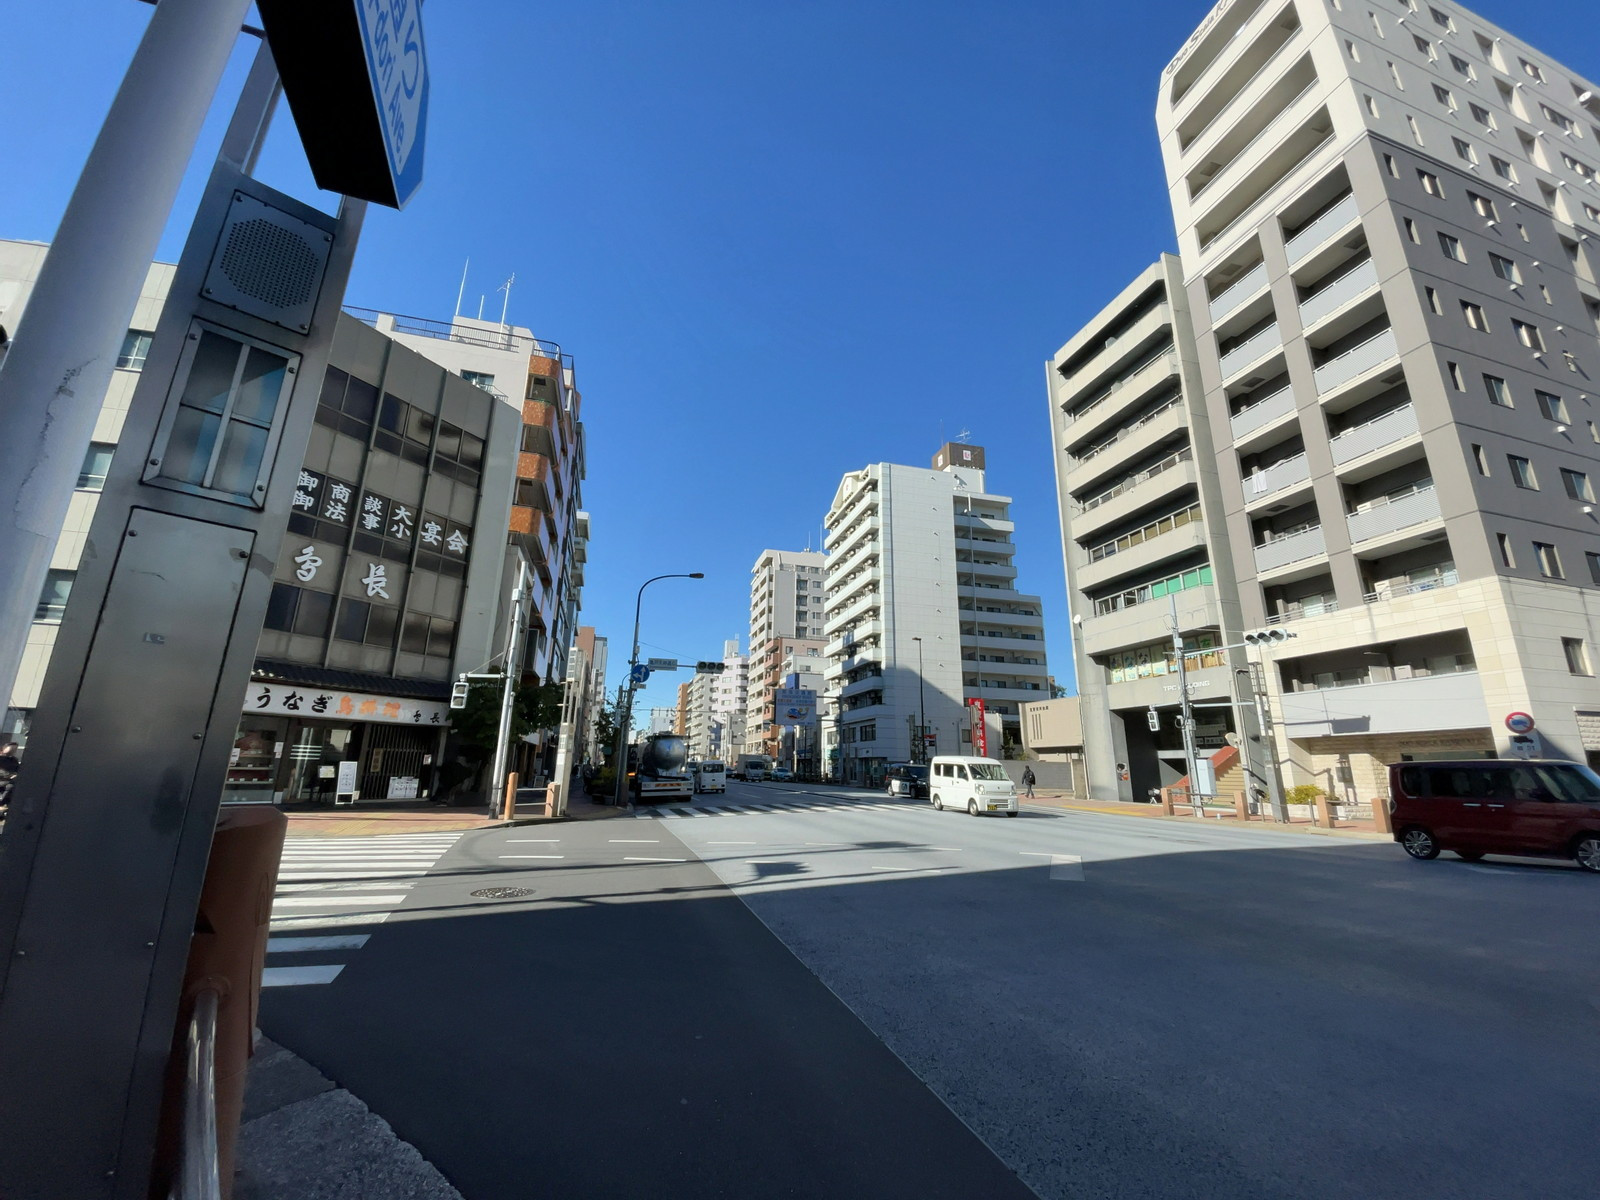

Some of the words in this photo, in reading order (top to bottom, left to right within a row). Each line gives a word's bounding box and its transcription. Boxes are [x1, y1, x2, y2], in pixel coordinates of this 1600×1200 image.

[388, 81, 405, 164] Ave.
[257, 687, 333, 713] うなぎ
[1163, 684, 1177, 692] TPC
